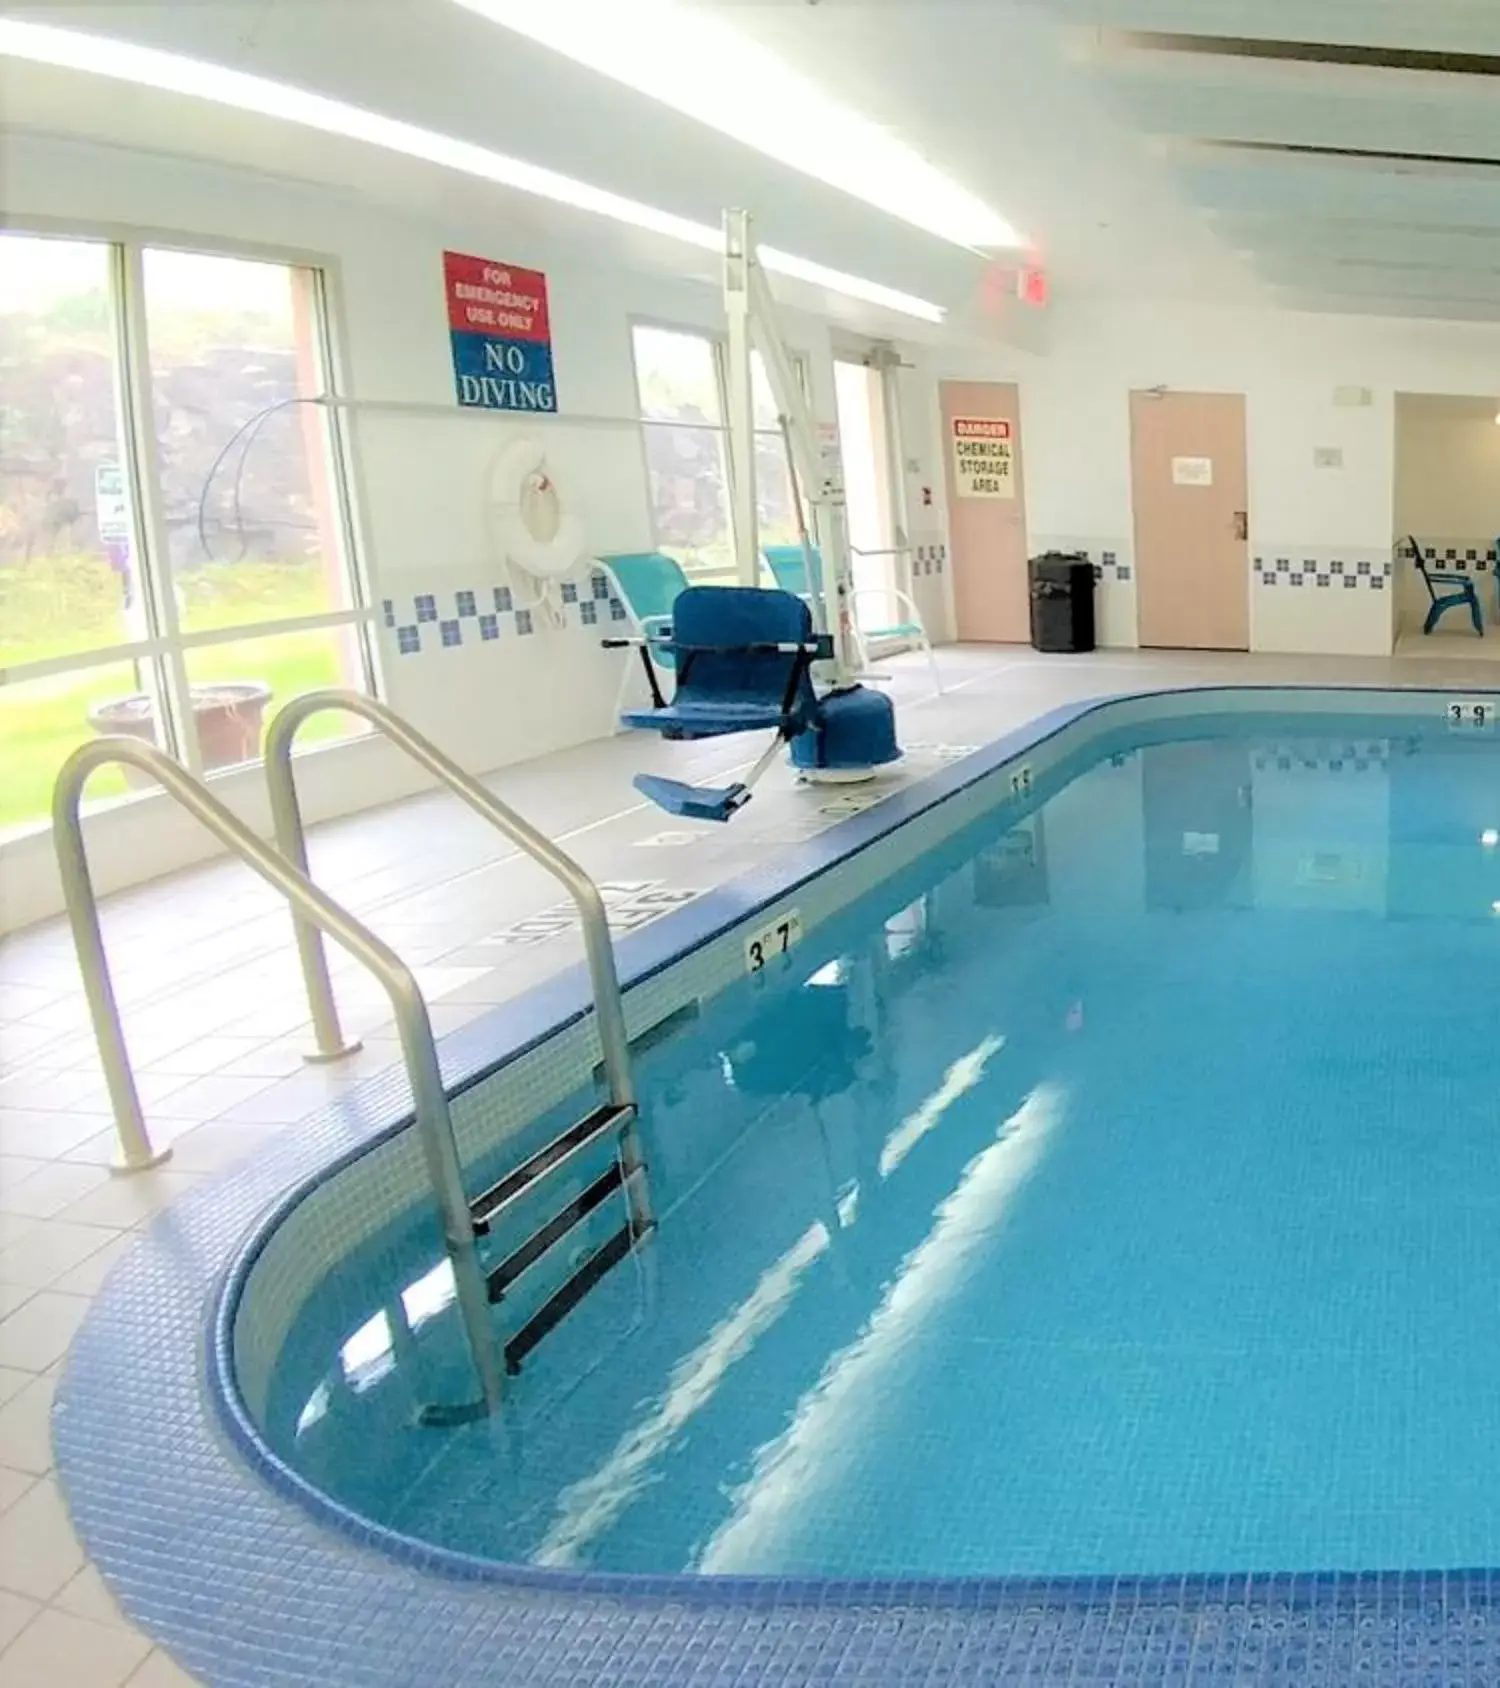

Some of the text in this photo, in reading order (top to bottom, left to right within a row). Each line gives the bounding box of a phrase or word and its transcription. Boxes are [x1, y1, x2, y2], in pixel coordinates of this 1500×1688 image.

[483, 266, 512, 287] FOR
[455, 281, 539, 312] EMERGENCY
[498, 311, 534, 331] ONLY
[485, 342, 525, 374] NO
[460, 374, 554, 410] DIVING
[956, 440, 1010, 458] CHEMICAL
[959, 458, 1009, 476] STORAGE
[972, 478, 999, 493] AREA
[1450, 705, 1461, 720] 3
[749, 941, 765, 973] 3
[777, 922, 789, 953] 7
